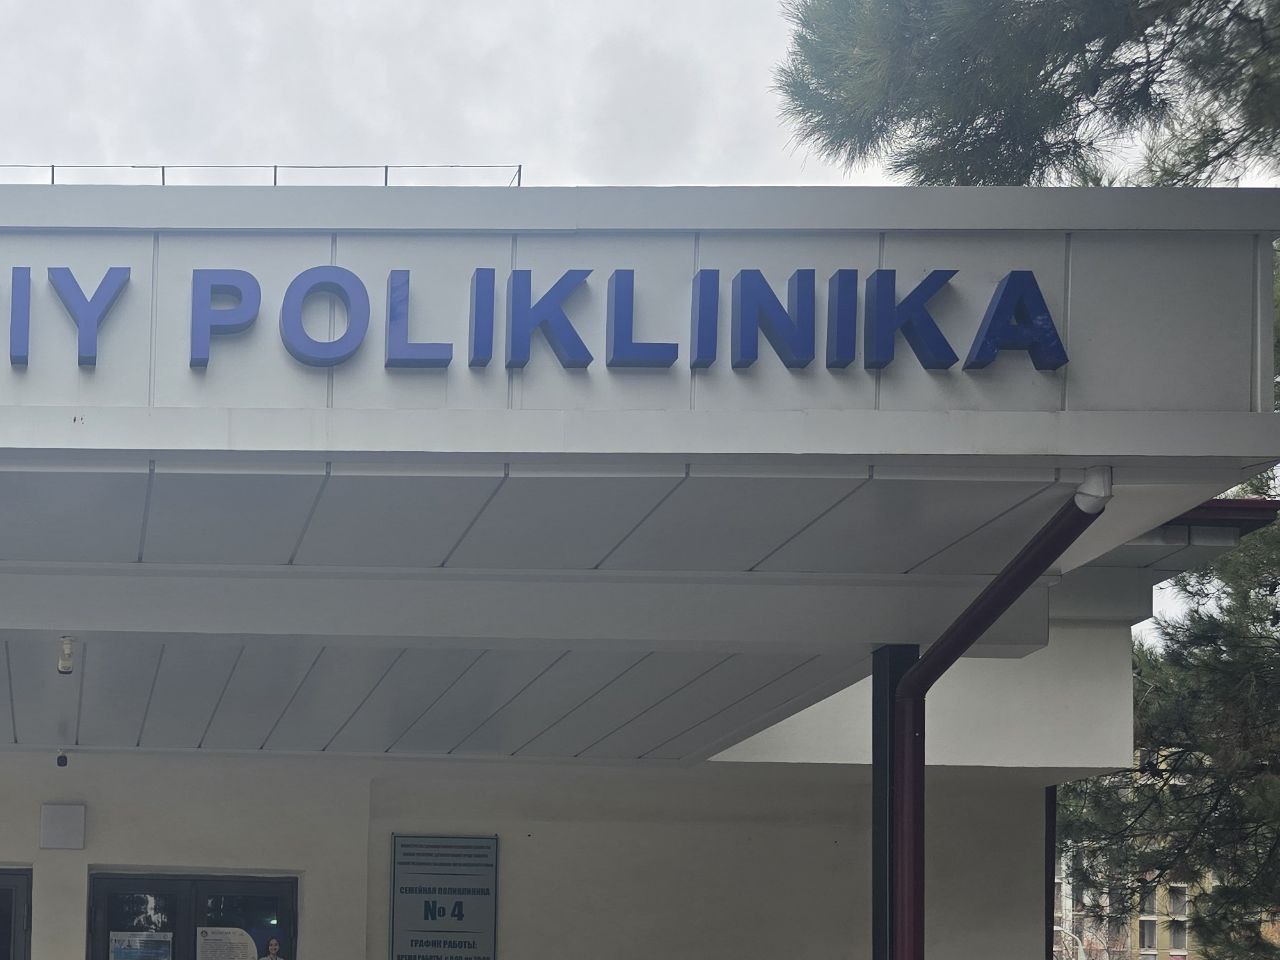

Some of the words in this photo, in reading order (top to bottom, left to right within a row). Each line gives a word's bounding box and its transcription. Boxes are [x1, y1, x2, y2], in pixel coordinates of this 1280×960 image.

[189, 264, 1070, 371] POLIKLINIKA
[450, 900, 465, 921] 4
[410, 939, 442, 948] ГРАФИК
